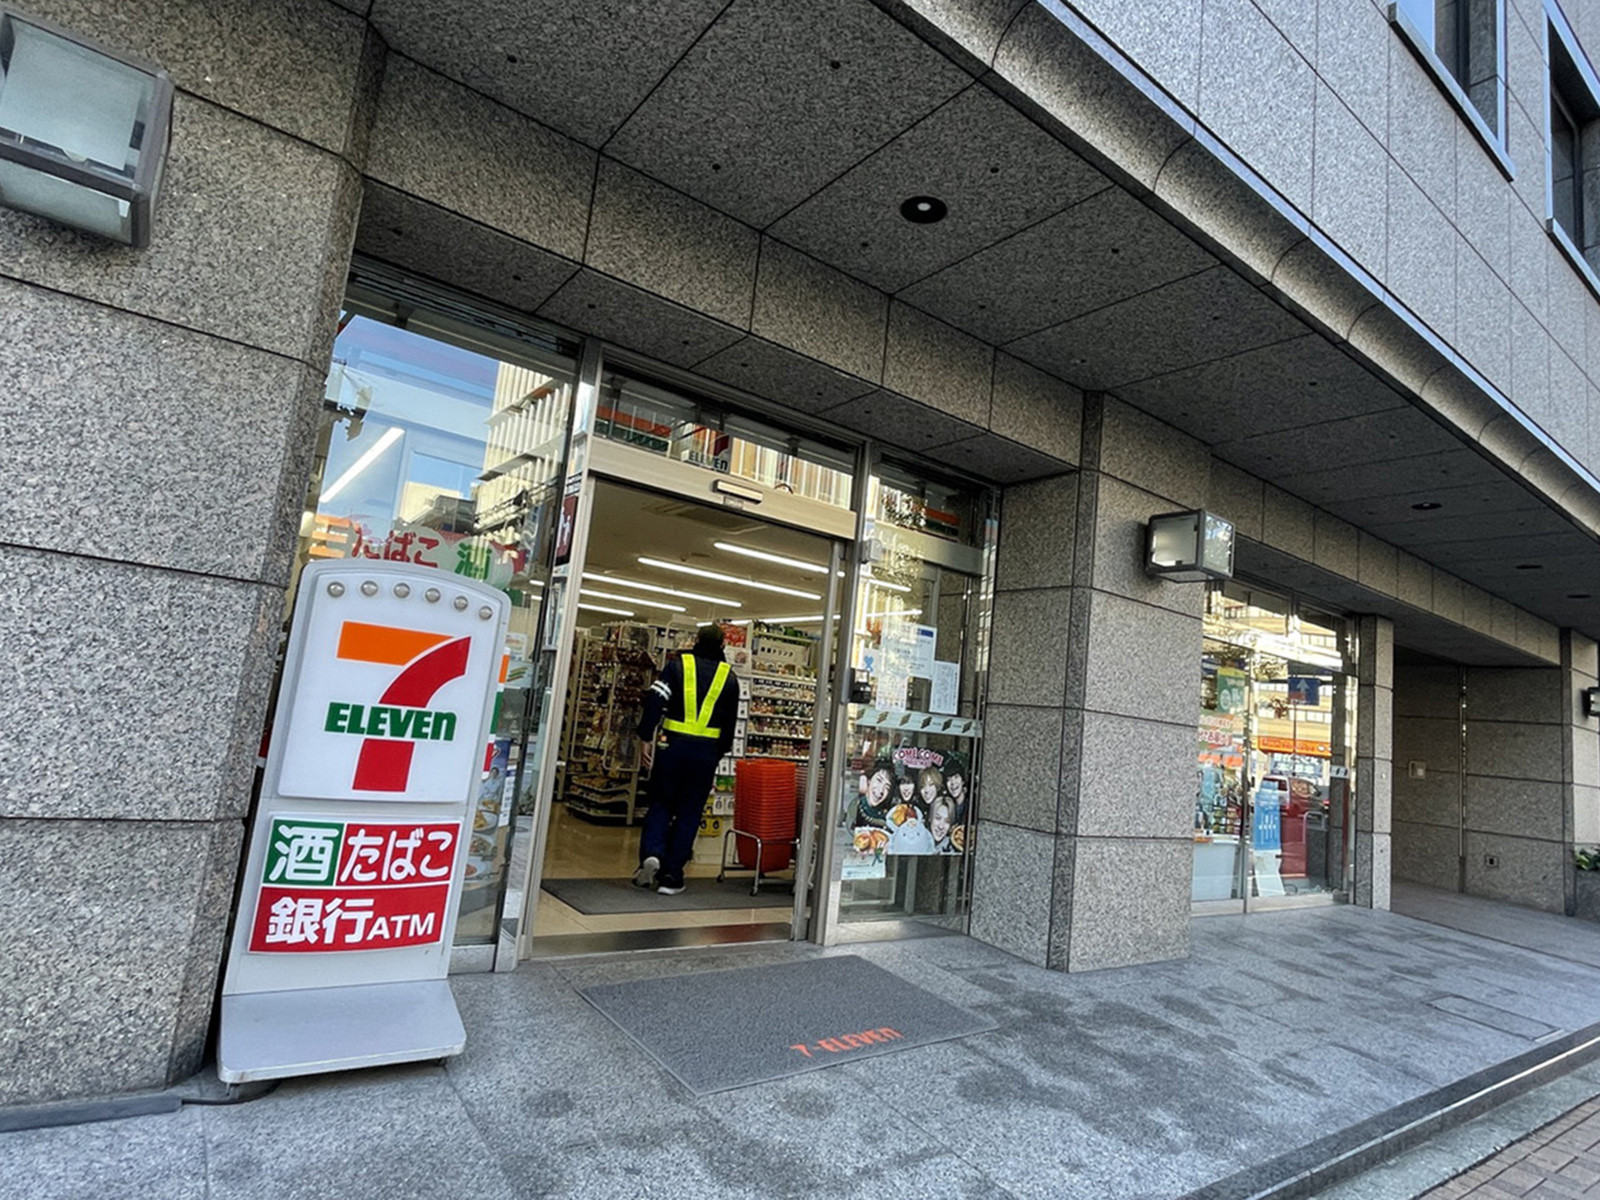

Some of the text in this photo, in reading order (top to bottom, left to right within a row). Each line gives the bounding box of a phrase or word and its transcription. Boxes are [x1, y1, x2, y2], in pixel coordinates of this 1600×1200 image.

[337, 621, 471, 793] 7
[268, 824, 453, 883] 酒 たばこ
